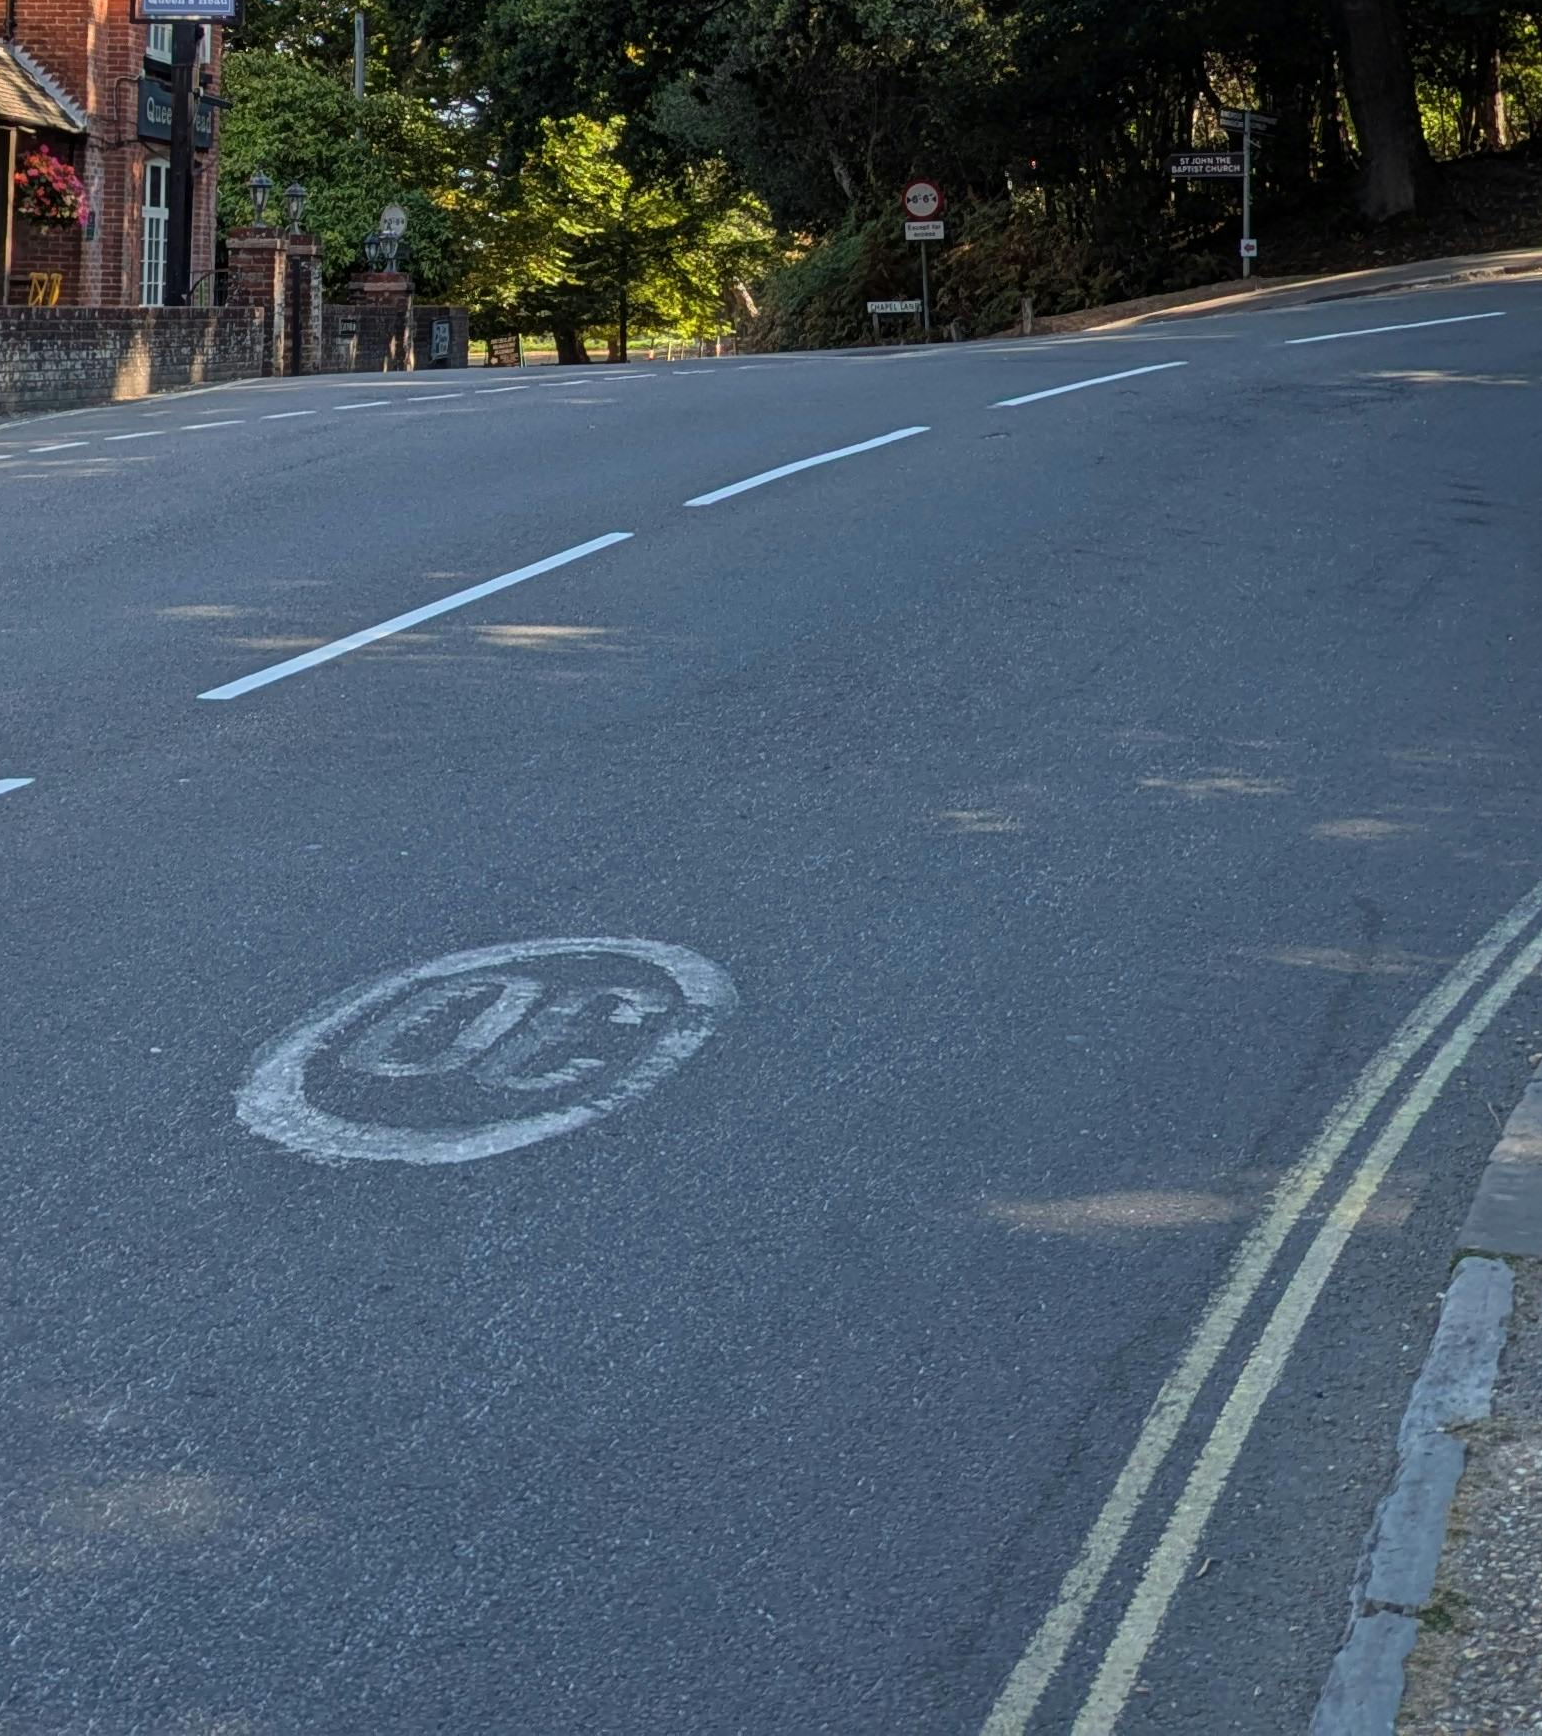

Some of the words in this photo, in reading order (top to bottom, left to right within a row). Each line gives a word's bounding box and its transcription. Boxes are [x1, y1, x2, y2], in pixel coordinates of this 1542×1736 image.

[146, 96, 172, 125] Quee
[193, 111, 212, 134] ead
[1180, 157, 1189, 165] ST
[1192, 157, 1213, 165] JOHN
[1215, 156, 1231, 165] THE
[1171, 165, 1204, 174] BAPTIST
[1205, 164, 1241, 173] CHURCH
